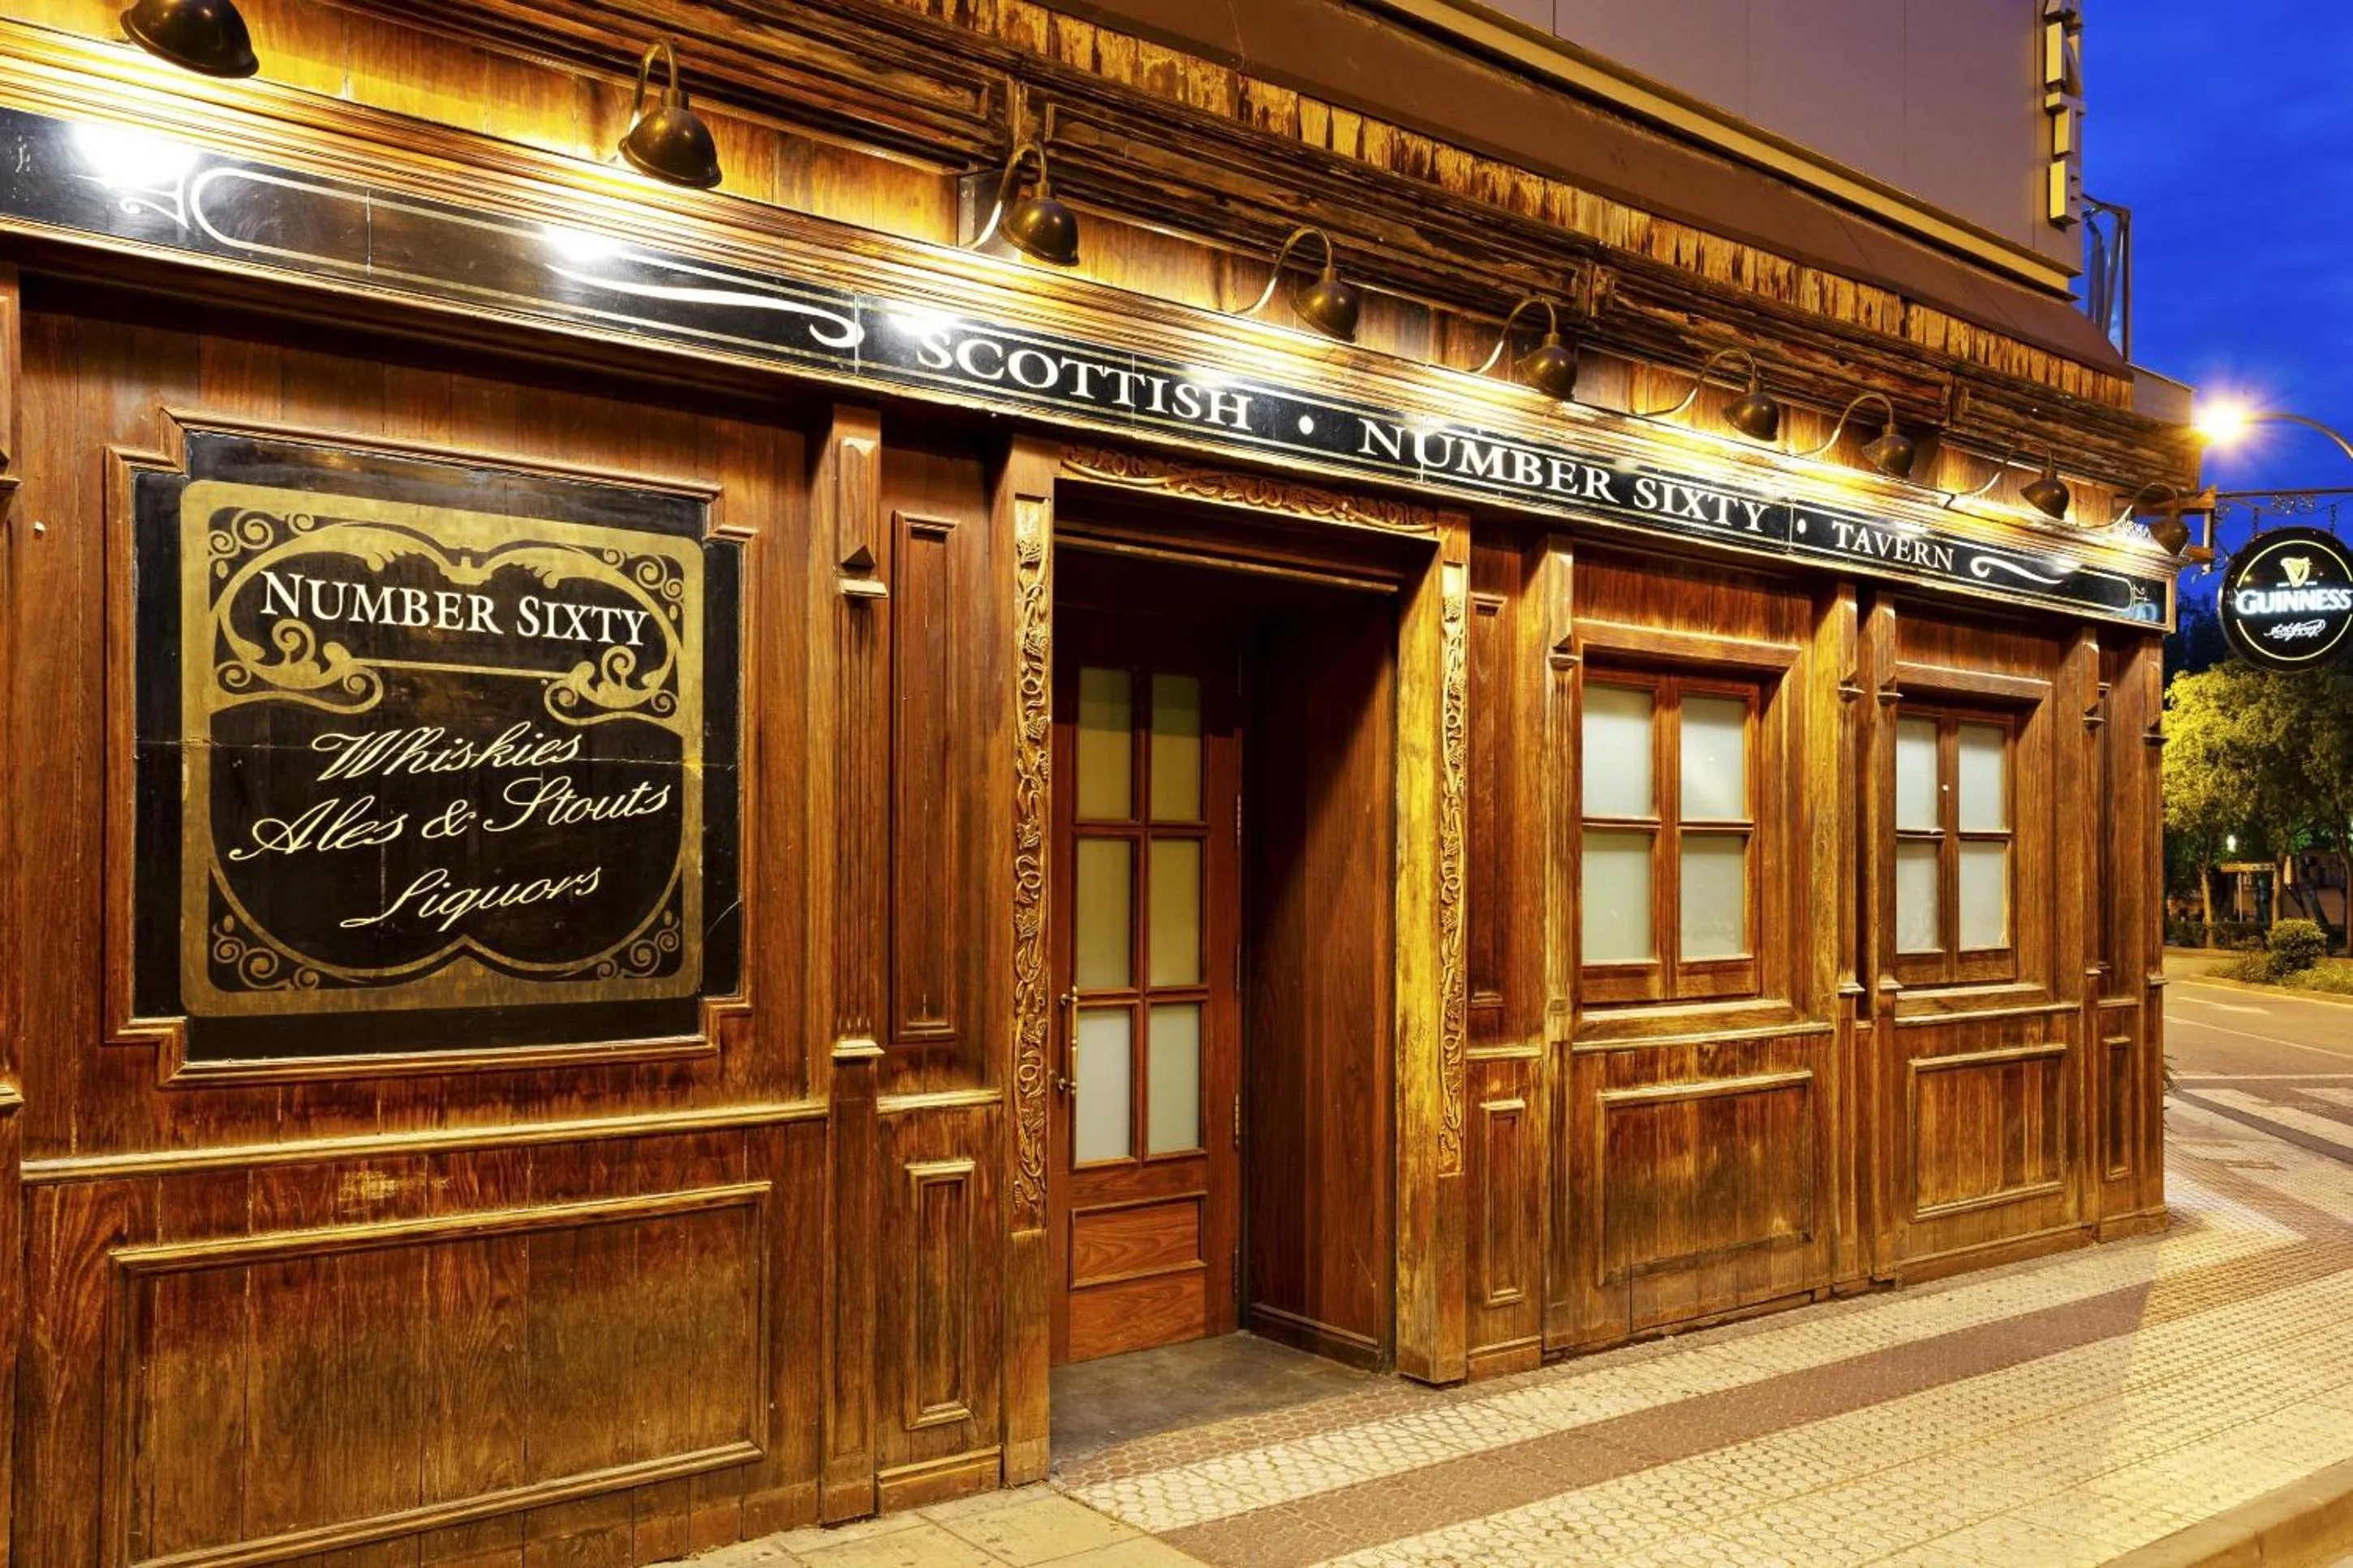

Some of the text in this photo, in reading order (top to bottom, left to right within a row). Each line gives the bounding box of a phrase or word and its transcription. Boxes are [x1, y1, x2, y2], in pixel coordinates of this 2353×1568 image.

[915, 329, 1955, 572] SCOTTISH NUMBER SIXTY TAVERN
[260, 570, 649, 647] NUMBER SIXTY
[2235, 589, 2353, 615] GUINNESS
[312, 720, 582, 782] Whiskies
[228, 775, 671, 861] Ales & Stouts
[340, 866, 602, 933] Liquors
